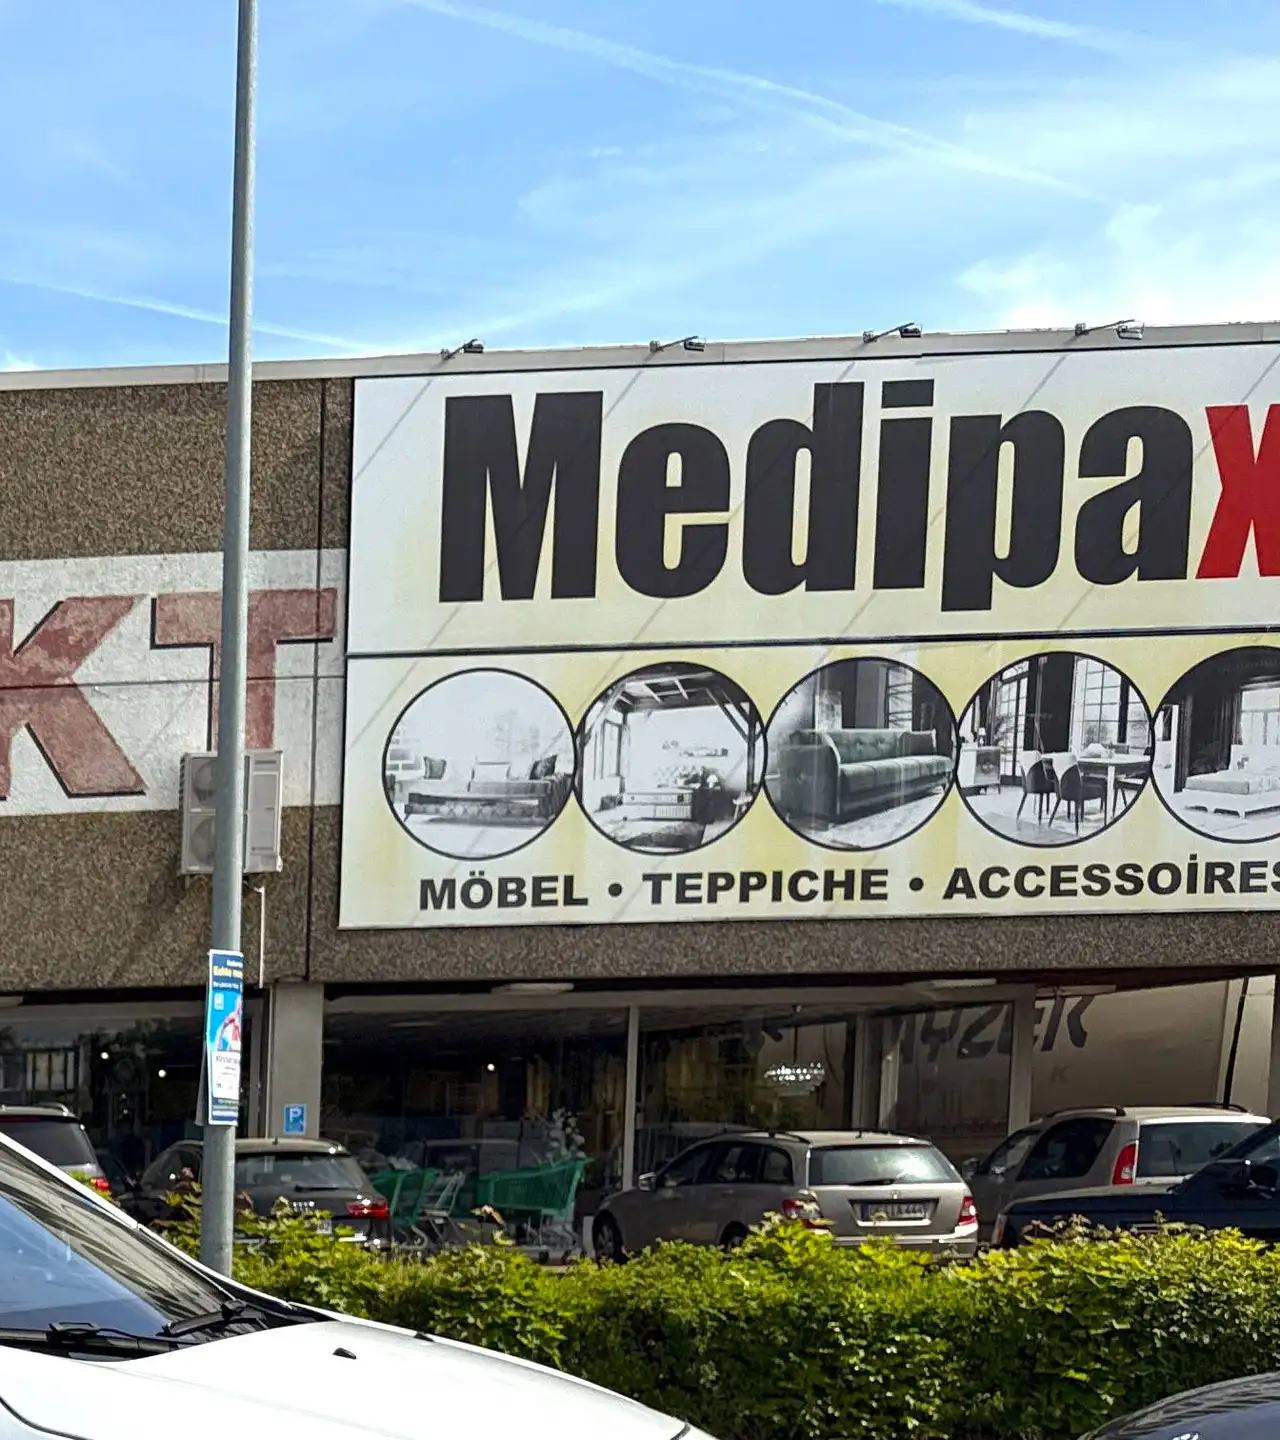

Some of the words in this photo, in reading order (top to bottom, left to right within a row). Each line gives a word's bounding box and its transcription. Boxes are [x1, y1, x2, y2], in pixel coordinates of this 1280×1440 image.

[439, 377, 1280, 613] Medipax
[418, 868, 588, 911] MÖBEL
[643, 868, 889, 905] TEPPICHE
